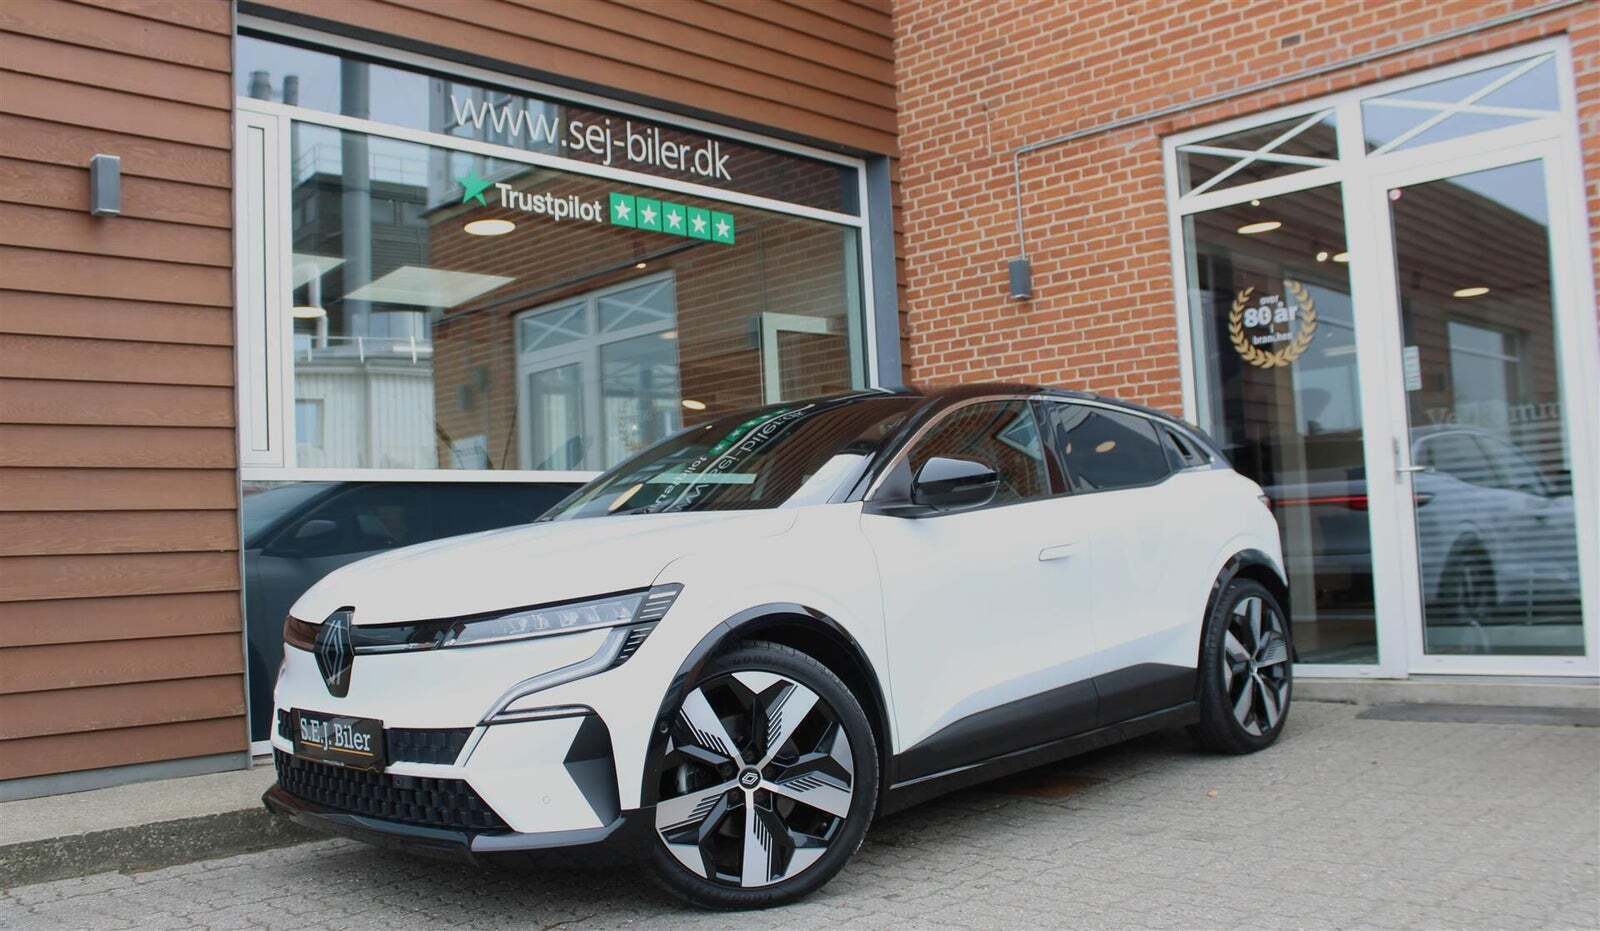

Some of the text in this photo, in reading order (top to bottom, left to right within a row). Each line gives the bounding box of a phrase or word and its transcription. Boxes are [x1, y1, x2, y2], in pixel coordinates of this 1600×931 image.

[451, 94, 732, 180] www.sej-biler.dk
[495, 182, 602, 222] Trustpilot
[1243, 300, 1298, 328] 80 år
[300, 717, 371, 751] S.E.J. Biler
